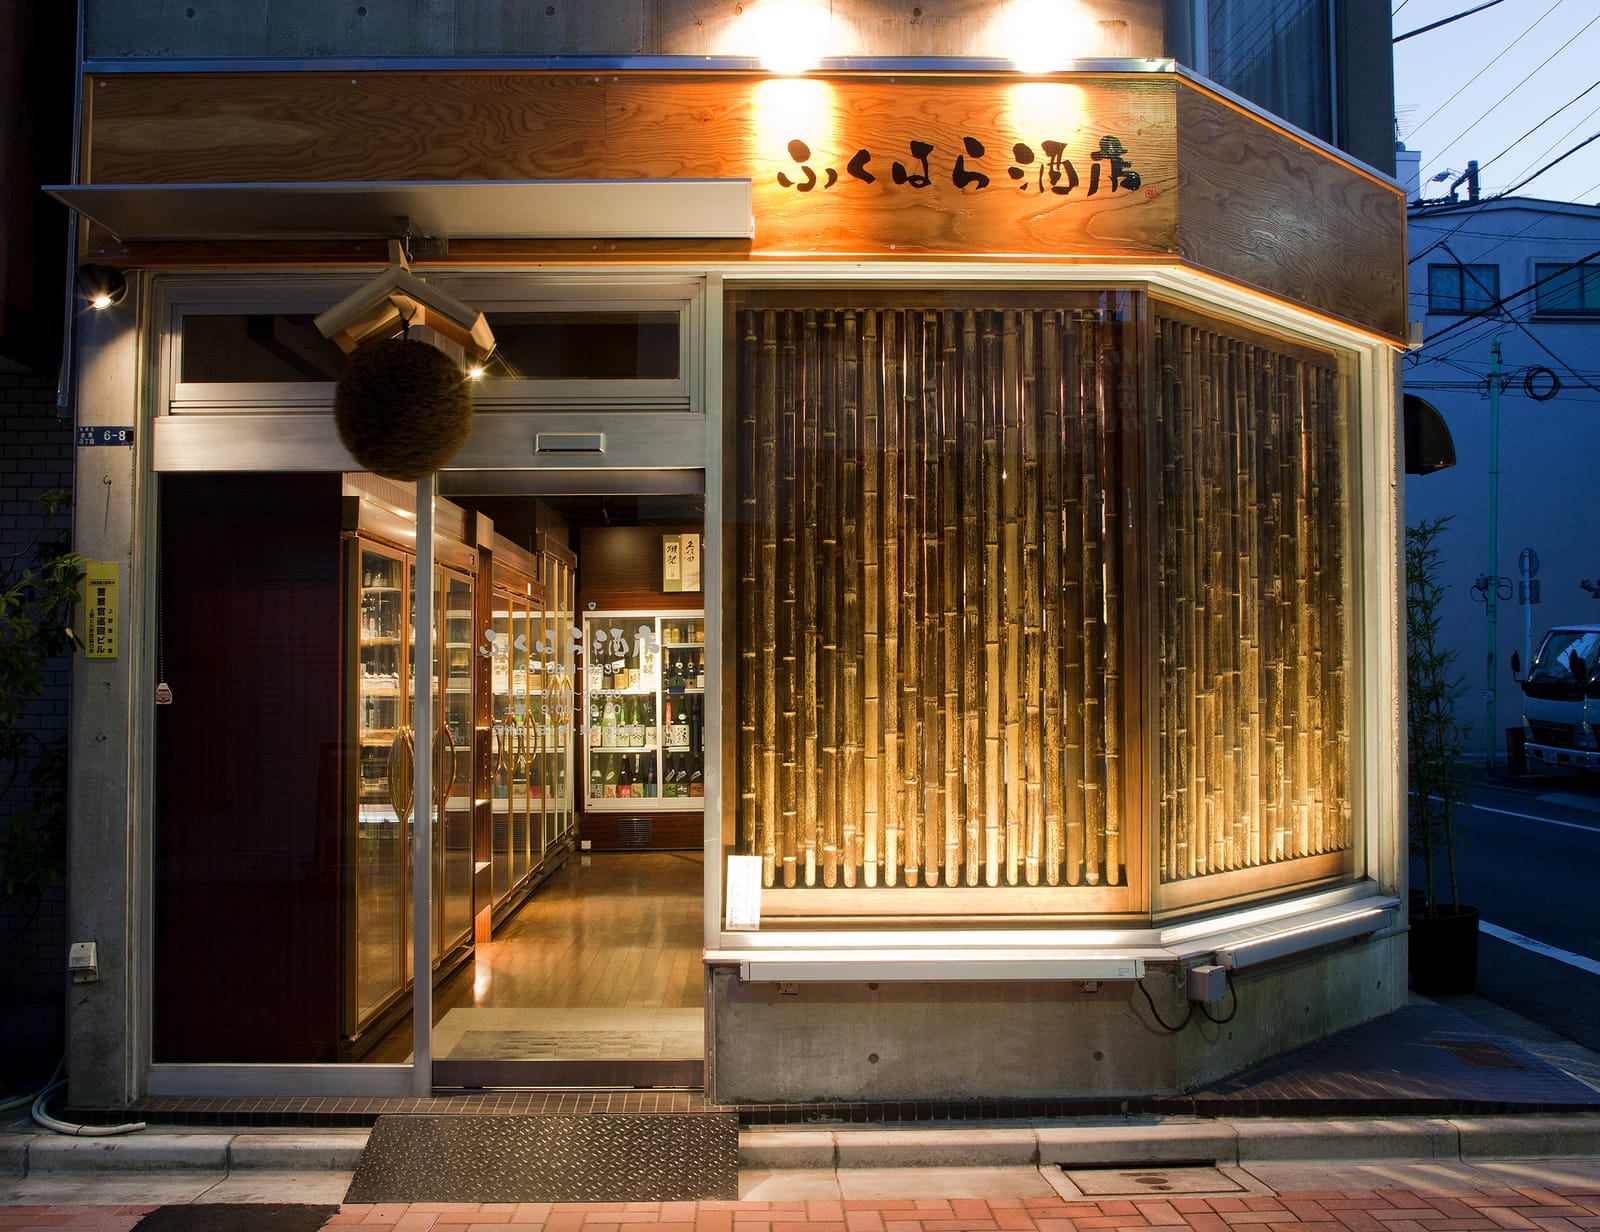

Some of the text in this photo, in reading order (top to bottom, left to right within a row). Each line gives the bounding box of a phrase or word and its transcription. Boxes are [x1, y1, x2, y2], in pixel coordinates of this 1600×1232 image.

[777, 135, 1142, 196] ふくはら酒店
[103, 430, 126, 441] 6-8
